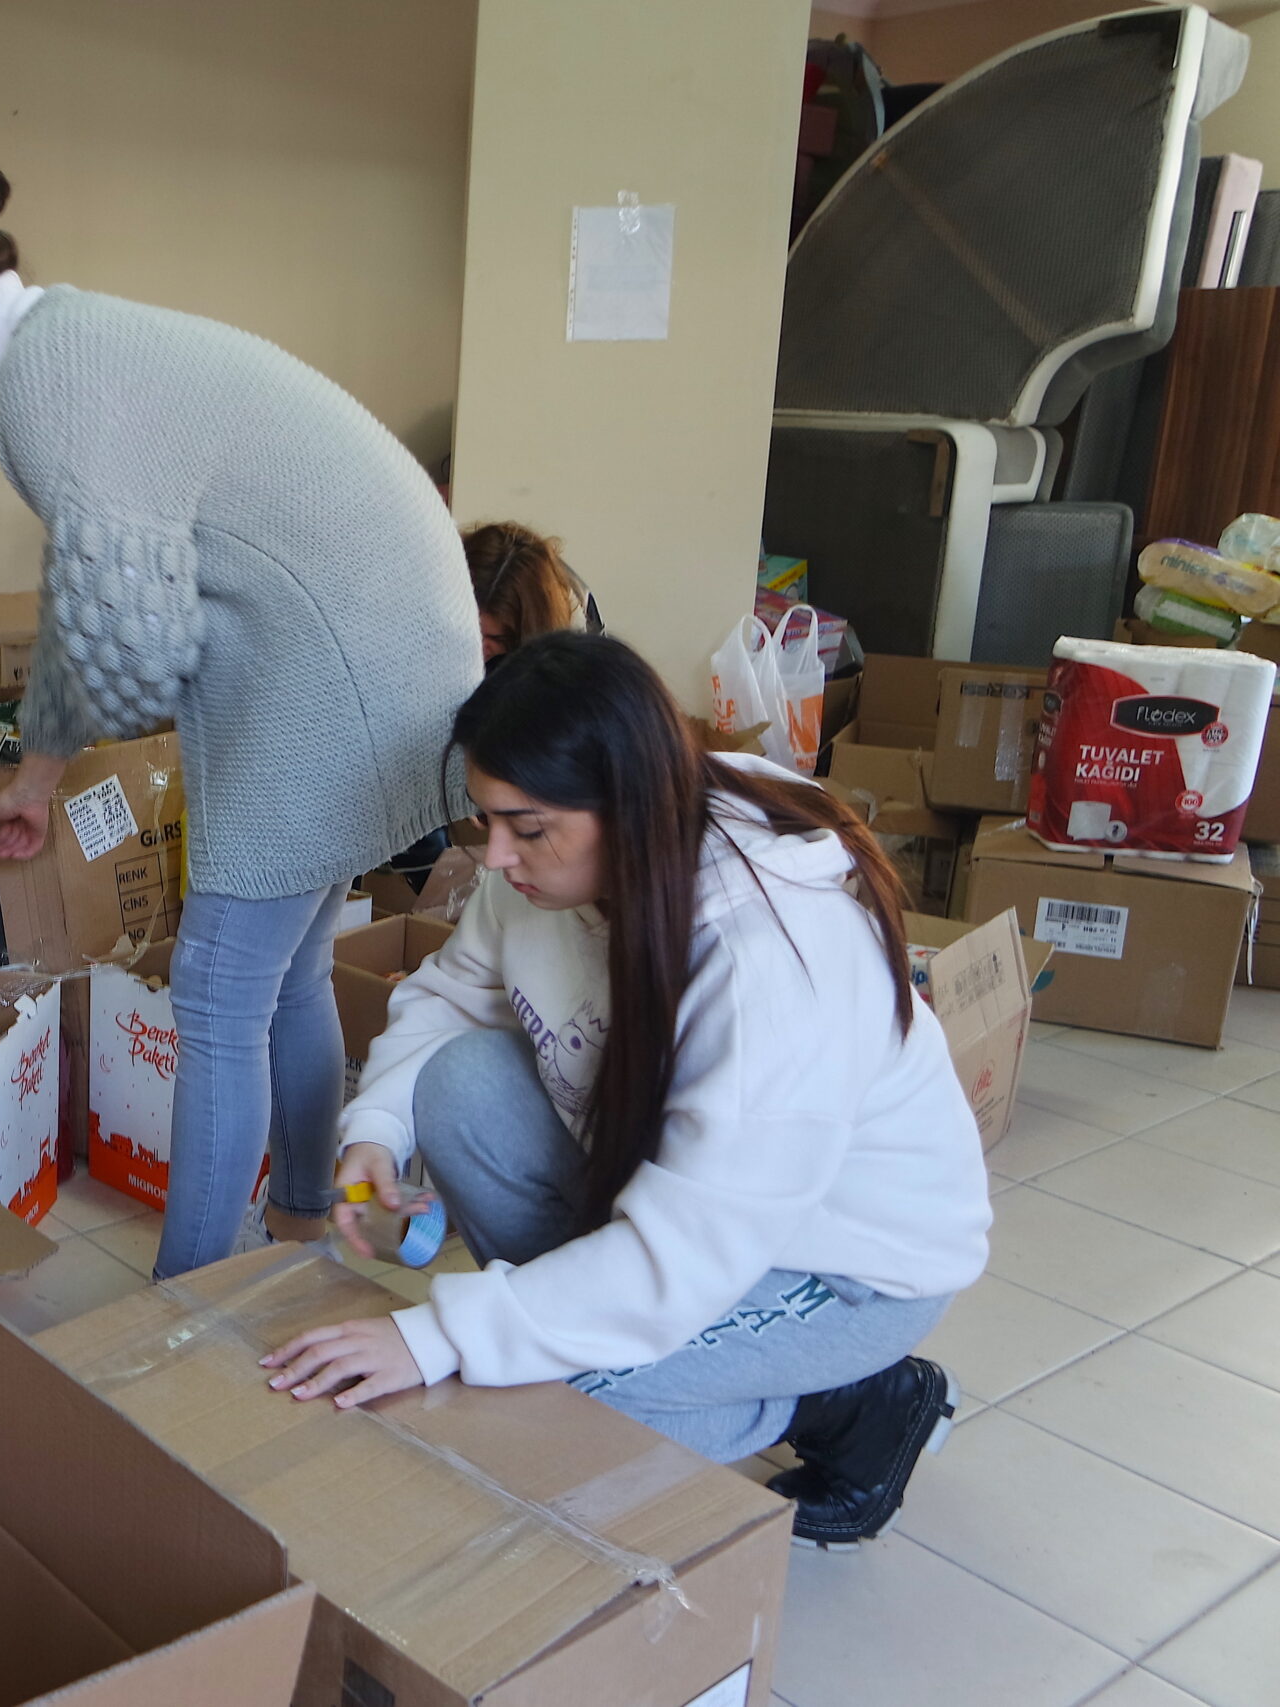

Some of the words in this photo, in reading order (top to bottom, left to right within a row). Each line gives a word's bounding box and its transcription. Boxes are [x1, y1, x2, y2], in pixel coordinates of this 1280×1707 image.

[1079, 744, 1164, 766] TUVALET
[1075, 760, 1141, 782] KAĞIDI
[1194, 822, 1225, 842] 32
[118, 866, 149, 885] RENK
[128, 927, 146, 941] NO
[11, 1026, 51, 1083] Bereket
